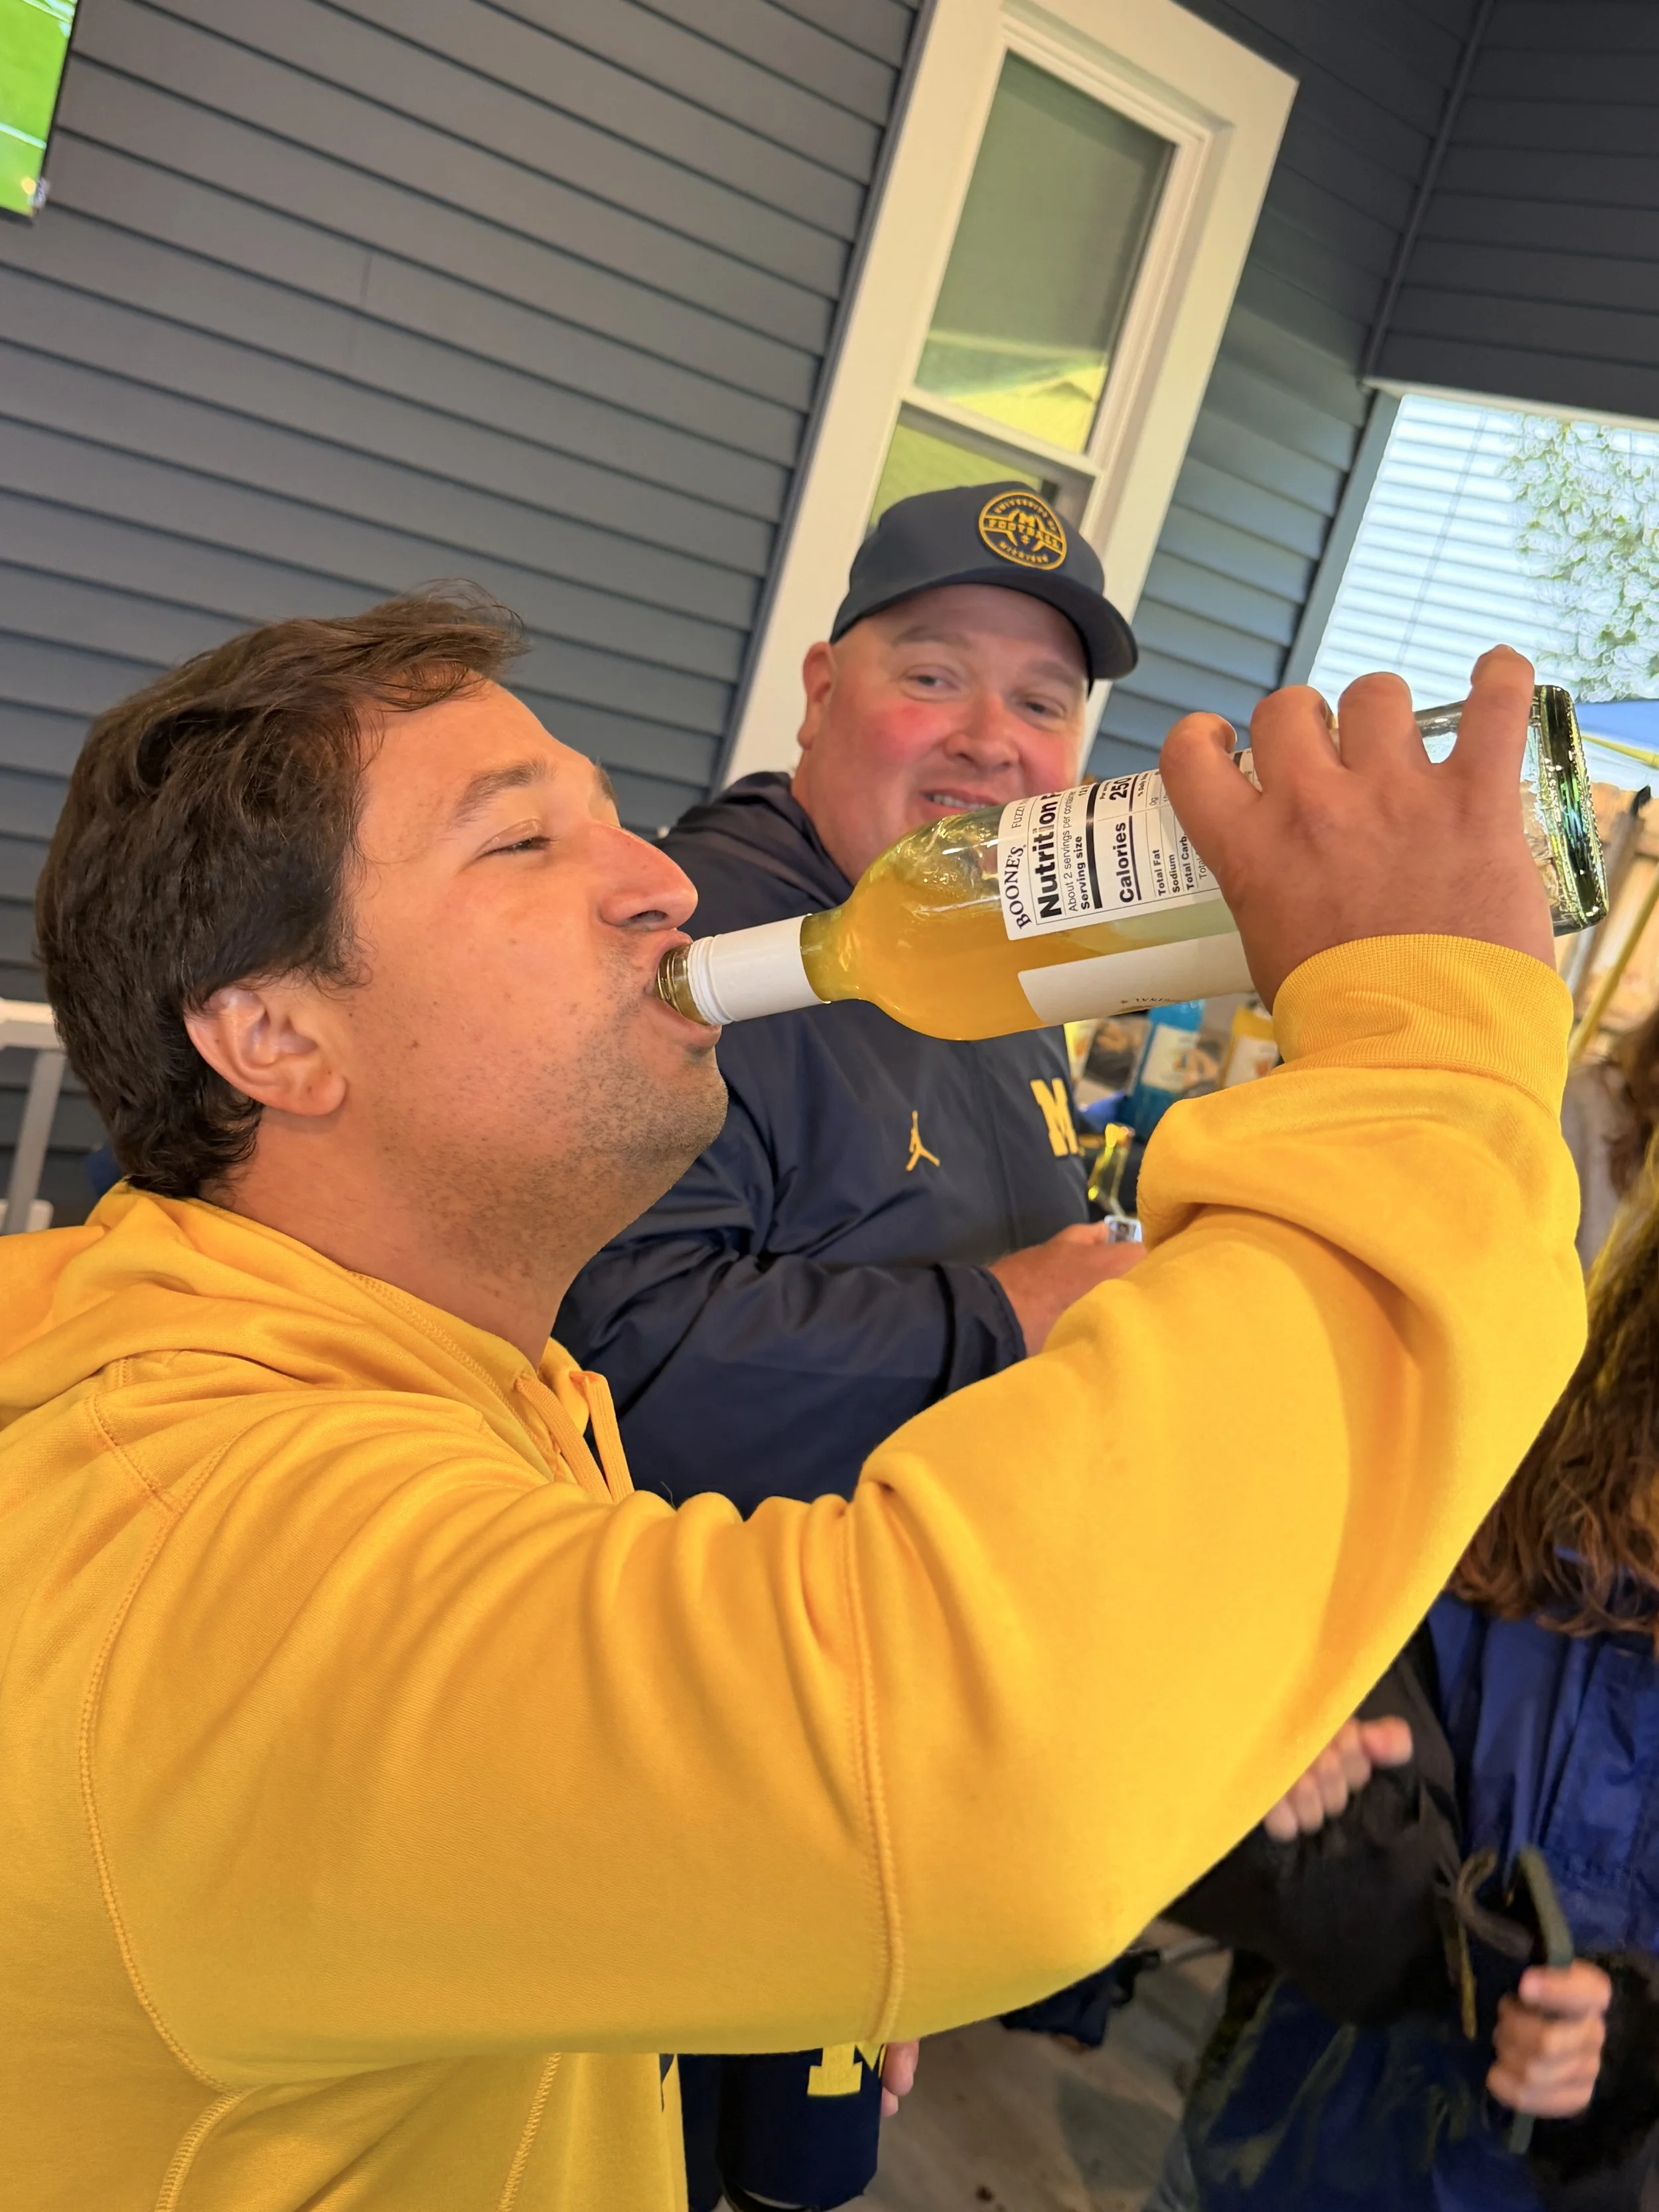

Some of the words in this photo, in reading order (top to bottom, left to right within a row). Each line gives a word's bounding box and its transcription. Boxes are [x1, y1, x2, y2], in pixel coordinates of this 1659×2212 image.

[1109, 777, 1132, 801] 250
[1033, 801, 1062, 919] Nutrition
[1062, 830, 1072, 869] servings
[1074, 836, 1082, 857] size
[1152, 849, 1161, 867] Fat
[1113, 822, 1133, 903] Calories
[1169, 854, 1181, 893] Sodium
[1183, 862, 1194, 891] Total
[1065, 882, 1078, 912] About
[1076, 862, 1090, 910] Serving
[1154, 868, 1166, 897] Total
